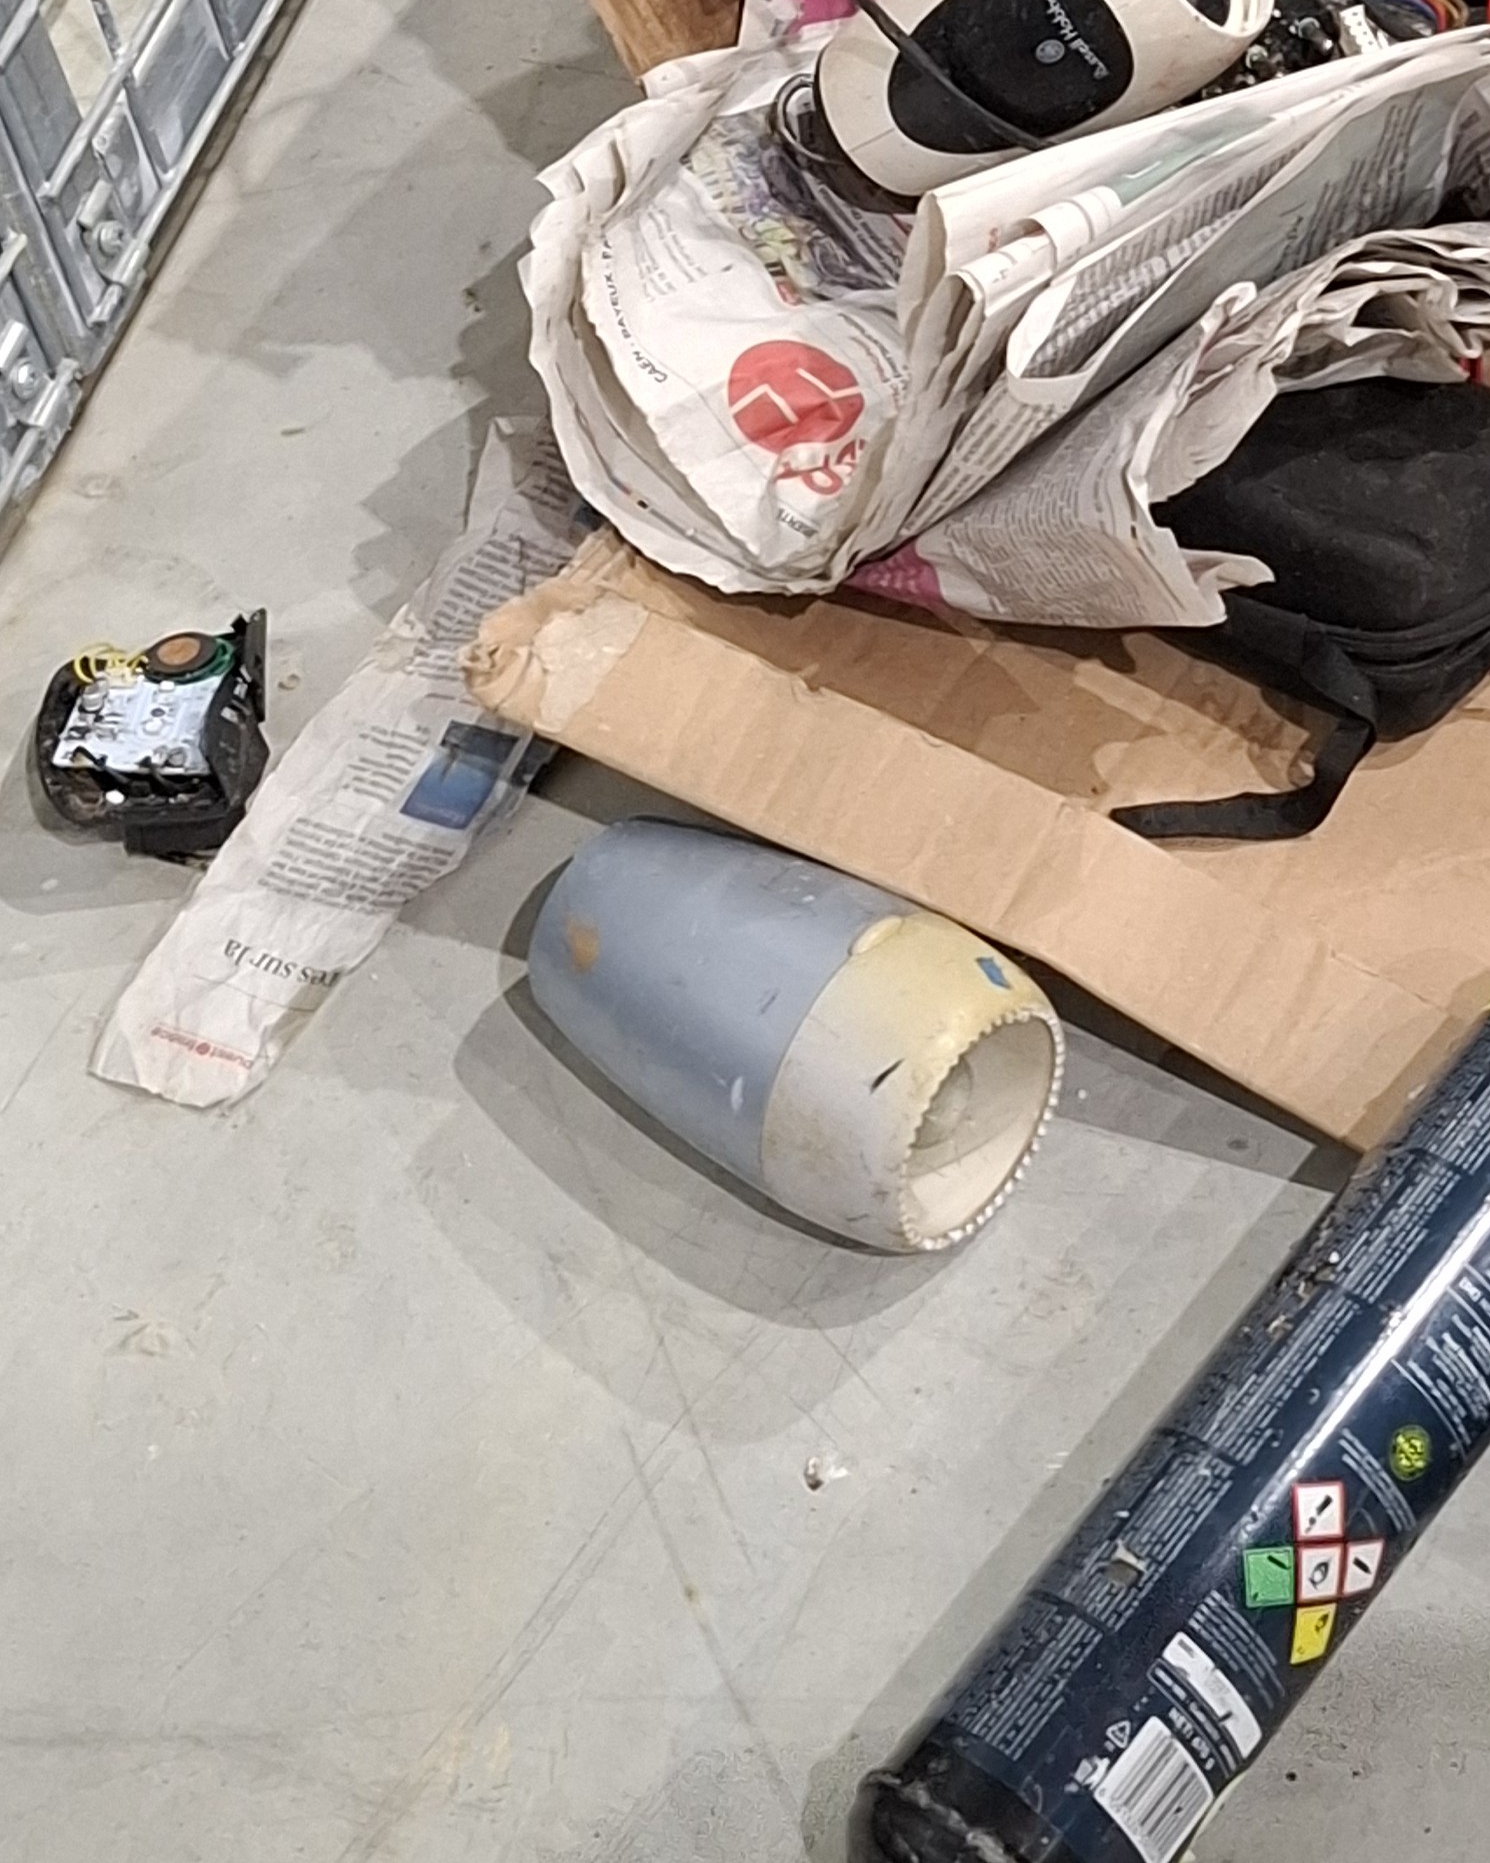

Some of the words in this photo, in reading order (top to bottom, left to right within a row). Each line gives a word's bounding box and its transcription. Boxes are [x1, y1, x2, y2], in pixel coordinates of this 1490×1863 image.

[1070, 37, 1108, 79] Russell
[604, 272, 631, 338] BAYEUX
[222, 938, 250, 968] la
[248, 949, 298, 982] sur
